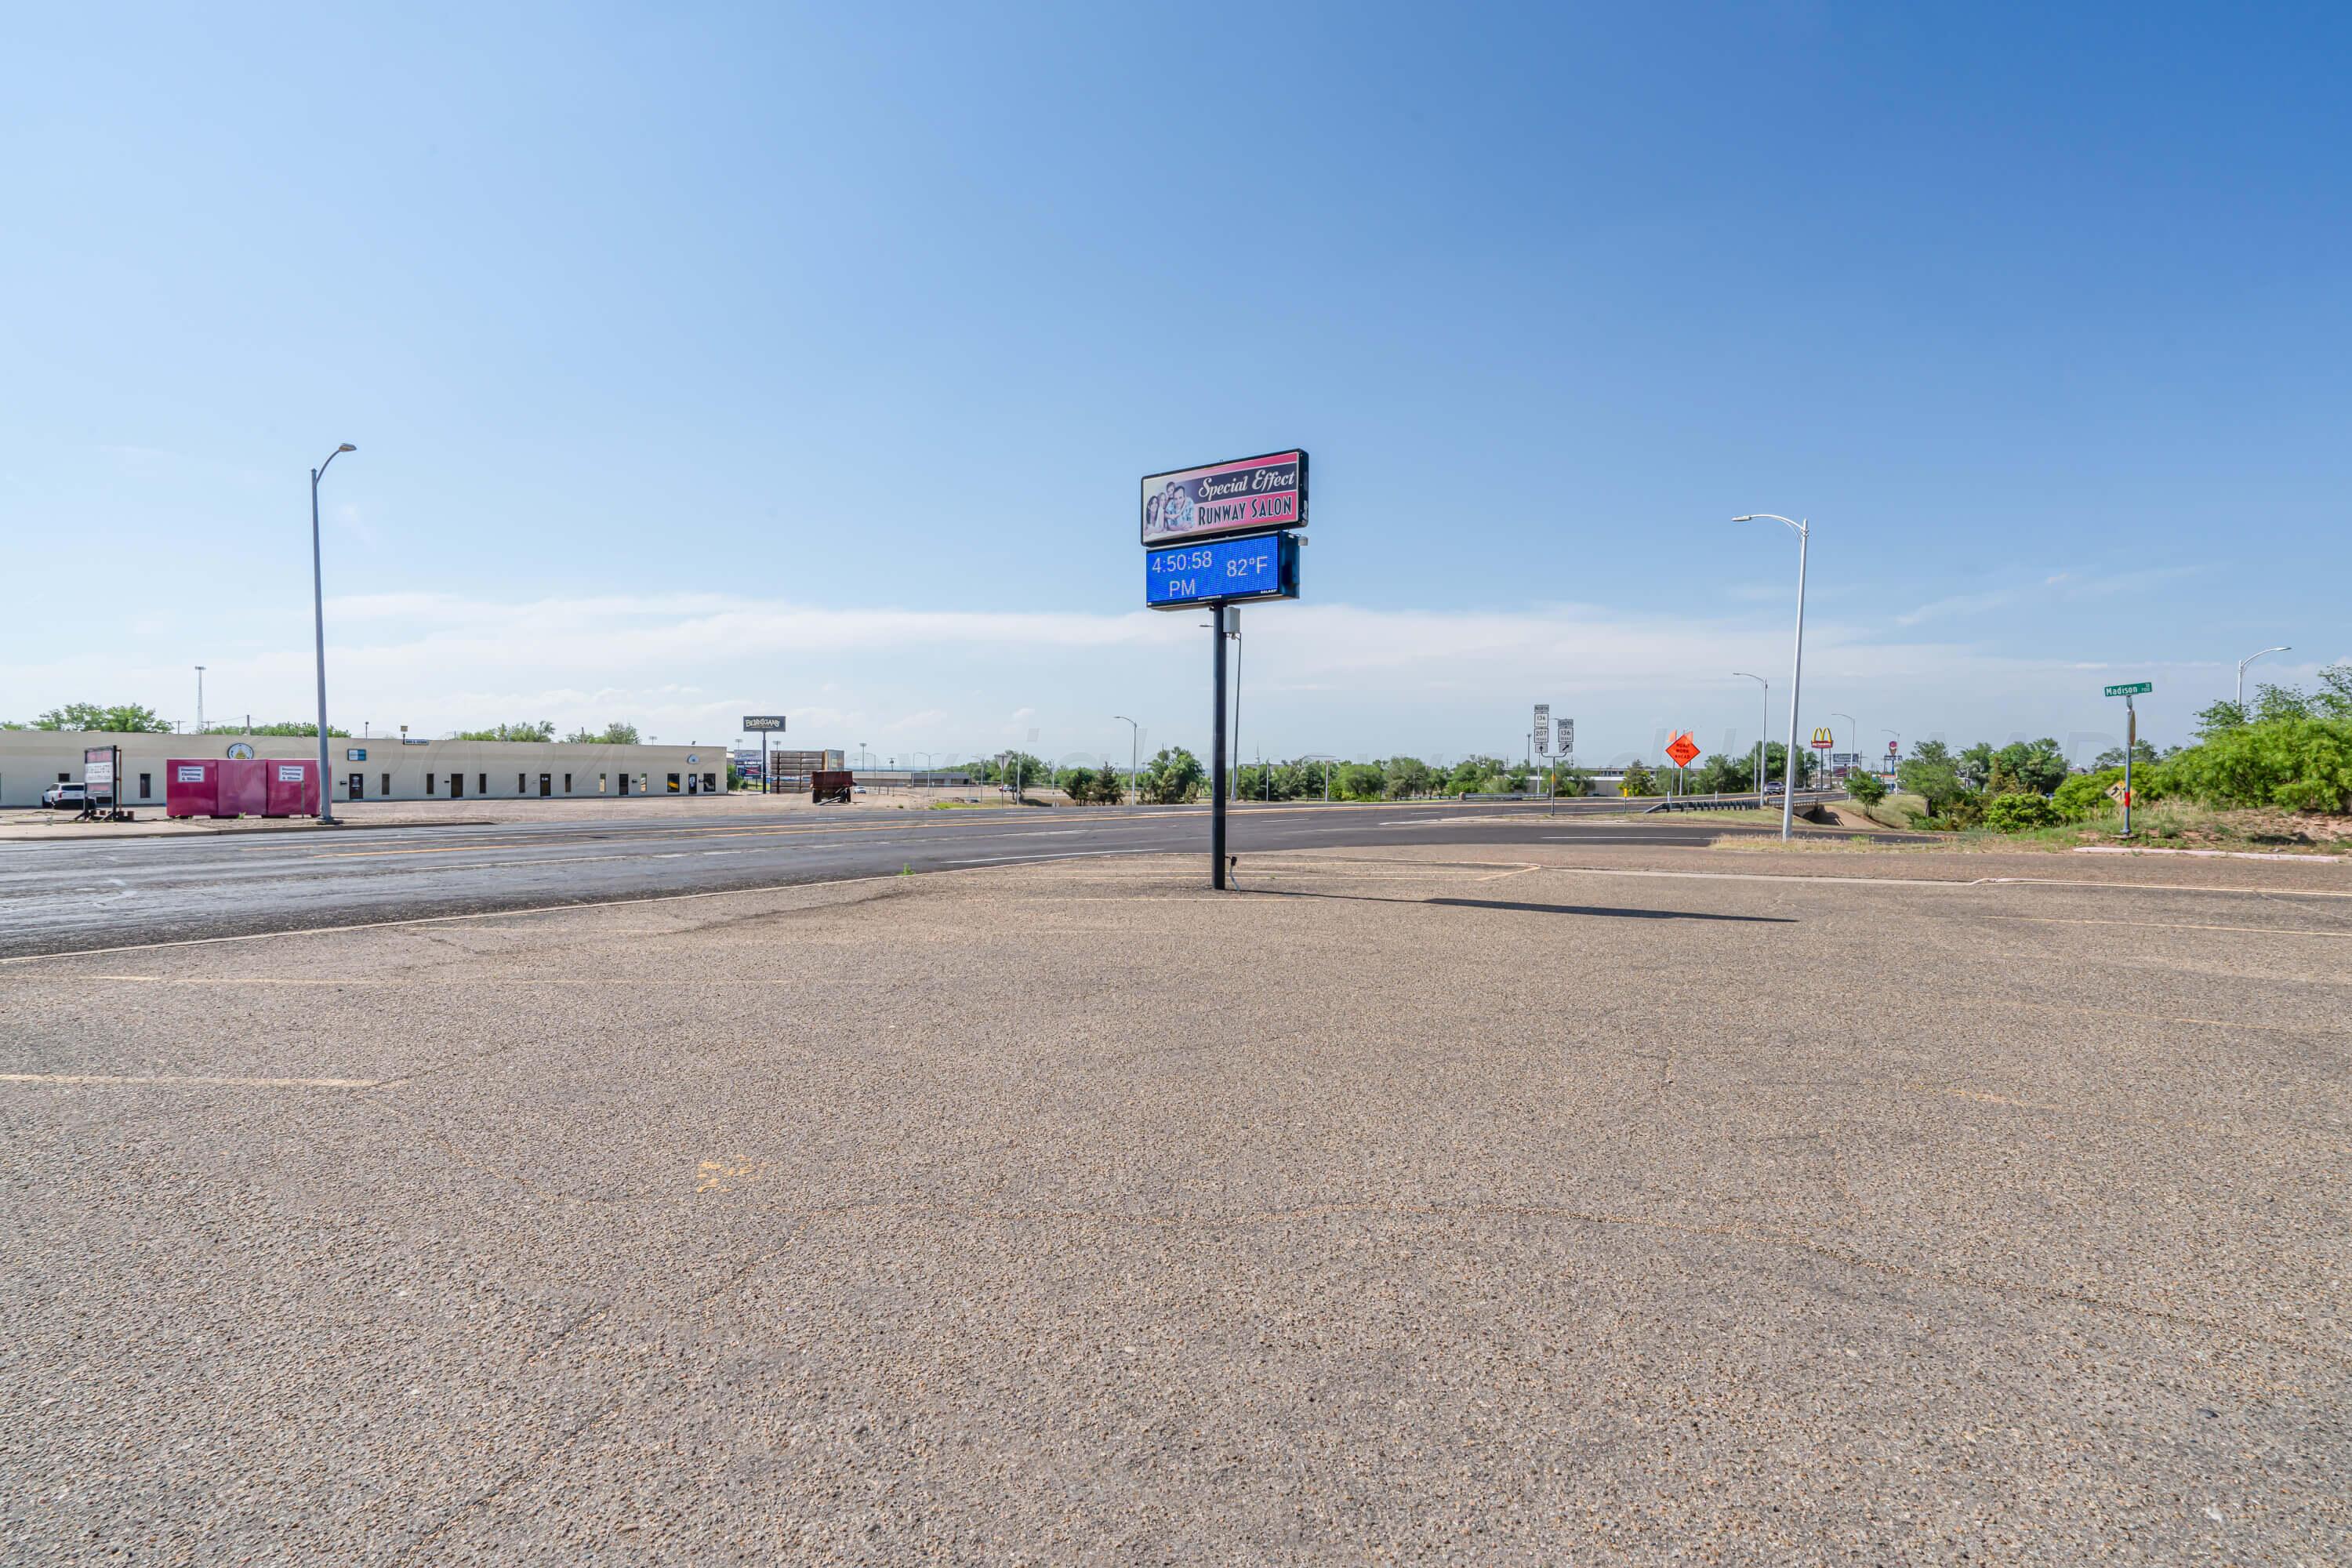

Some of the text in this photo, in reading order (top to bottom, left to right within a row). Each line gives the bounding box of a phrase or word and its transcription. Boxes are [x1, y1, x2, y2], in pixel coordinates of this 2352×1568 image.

[1199, 470, 1295, 501] Special Effect
[1198, 495, 1292, 526] RUNWAY SALON
[1152, 551, 1212, 573] 4:50:58
[1226, 556, 1268, 577] 82°F
[1169, 578, 1196, 597] PM
[2106, 687, 2138, 695] Madison
